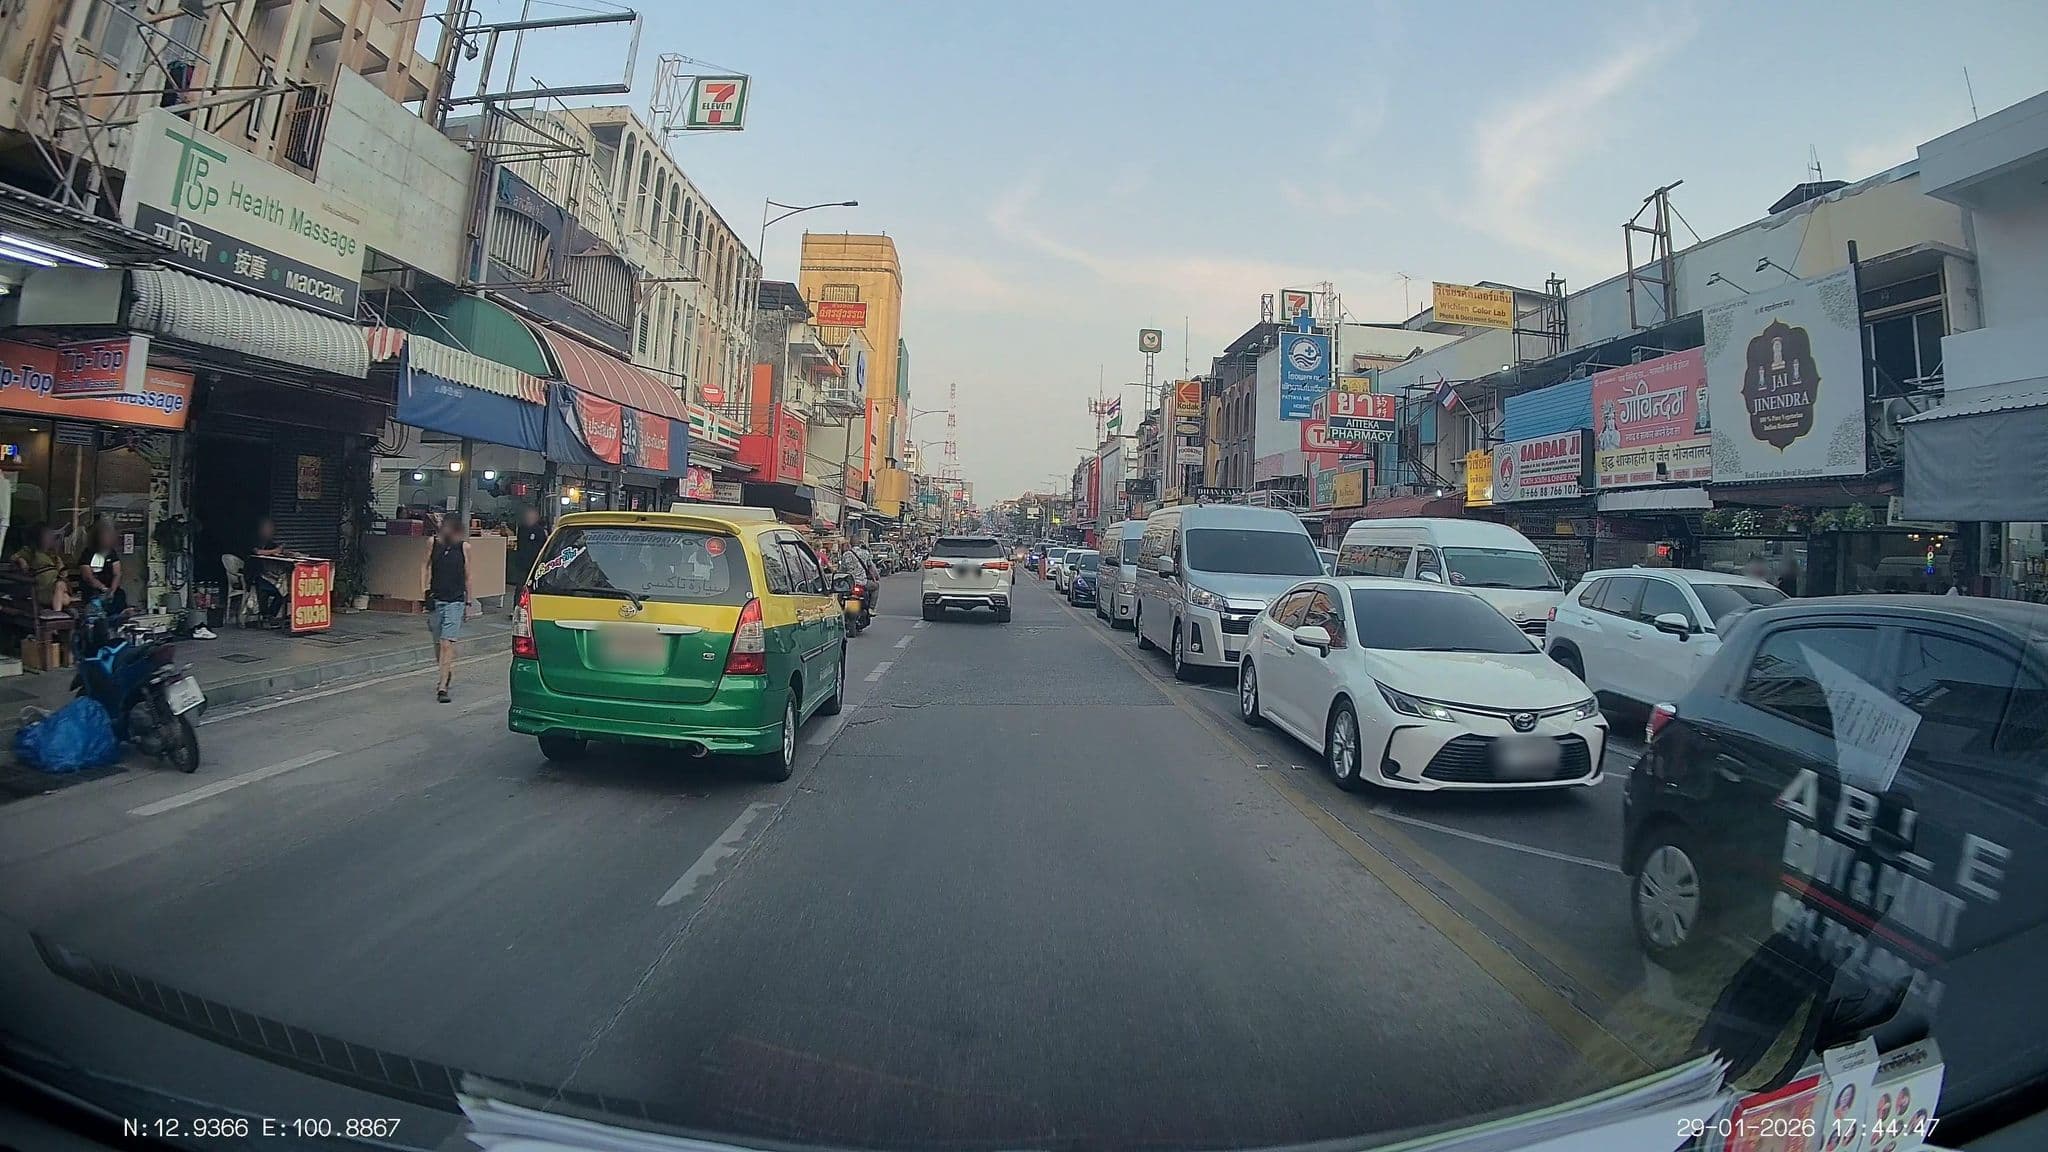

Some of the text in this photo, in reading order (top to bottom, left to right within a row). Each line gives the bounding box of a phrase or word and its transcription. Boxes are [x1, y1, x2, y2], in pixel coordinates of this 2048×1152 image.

[705, 84, 736, 124] 7
[229, 180, 285, 226] Health
[287, 207, 357, 258] Massage
[232, 247, 269, 281] 按摩
[1472, 306, 1492, 316] Color
[1493, 308, 1507, 317] Lab
[61, 346, 125, 377] Tip-Top
[0, 361, 53, 397] p-Top
[1771, 372, 1789, 392] JAI
[1177, 402, 1199, 410] Kodak
[1337, 392, 1374, 416] ยา
[1752, 391, 1811, 416] JINENDRA
[1331, 428, 1393, 442] PHARMACY
[1346, 419, 1379, 429] АПТЕКА
[1520, 438, 1567, 462] SARDAR
[1570, 436, 1581, 456] JI
